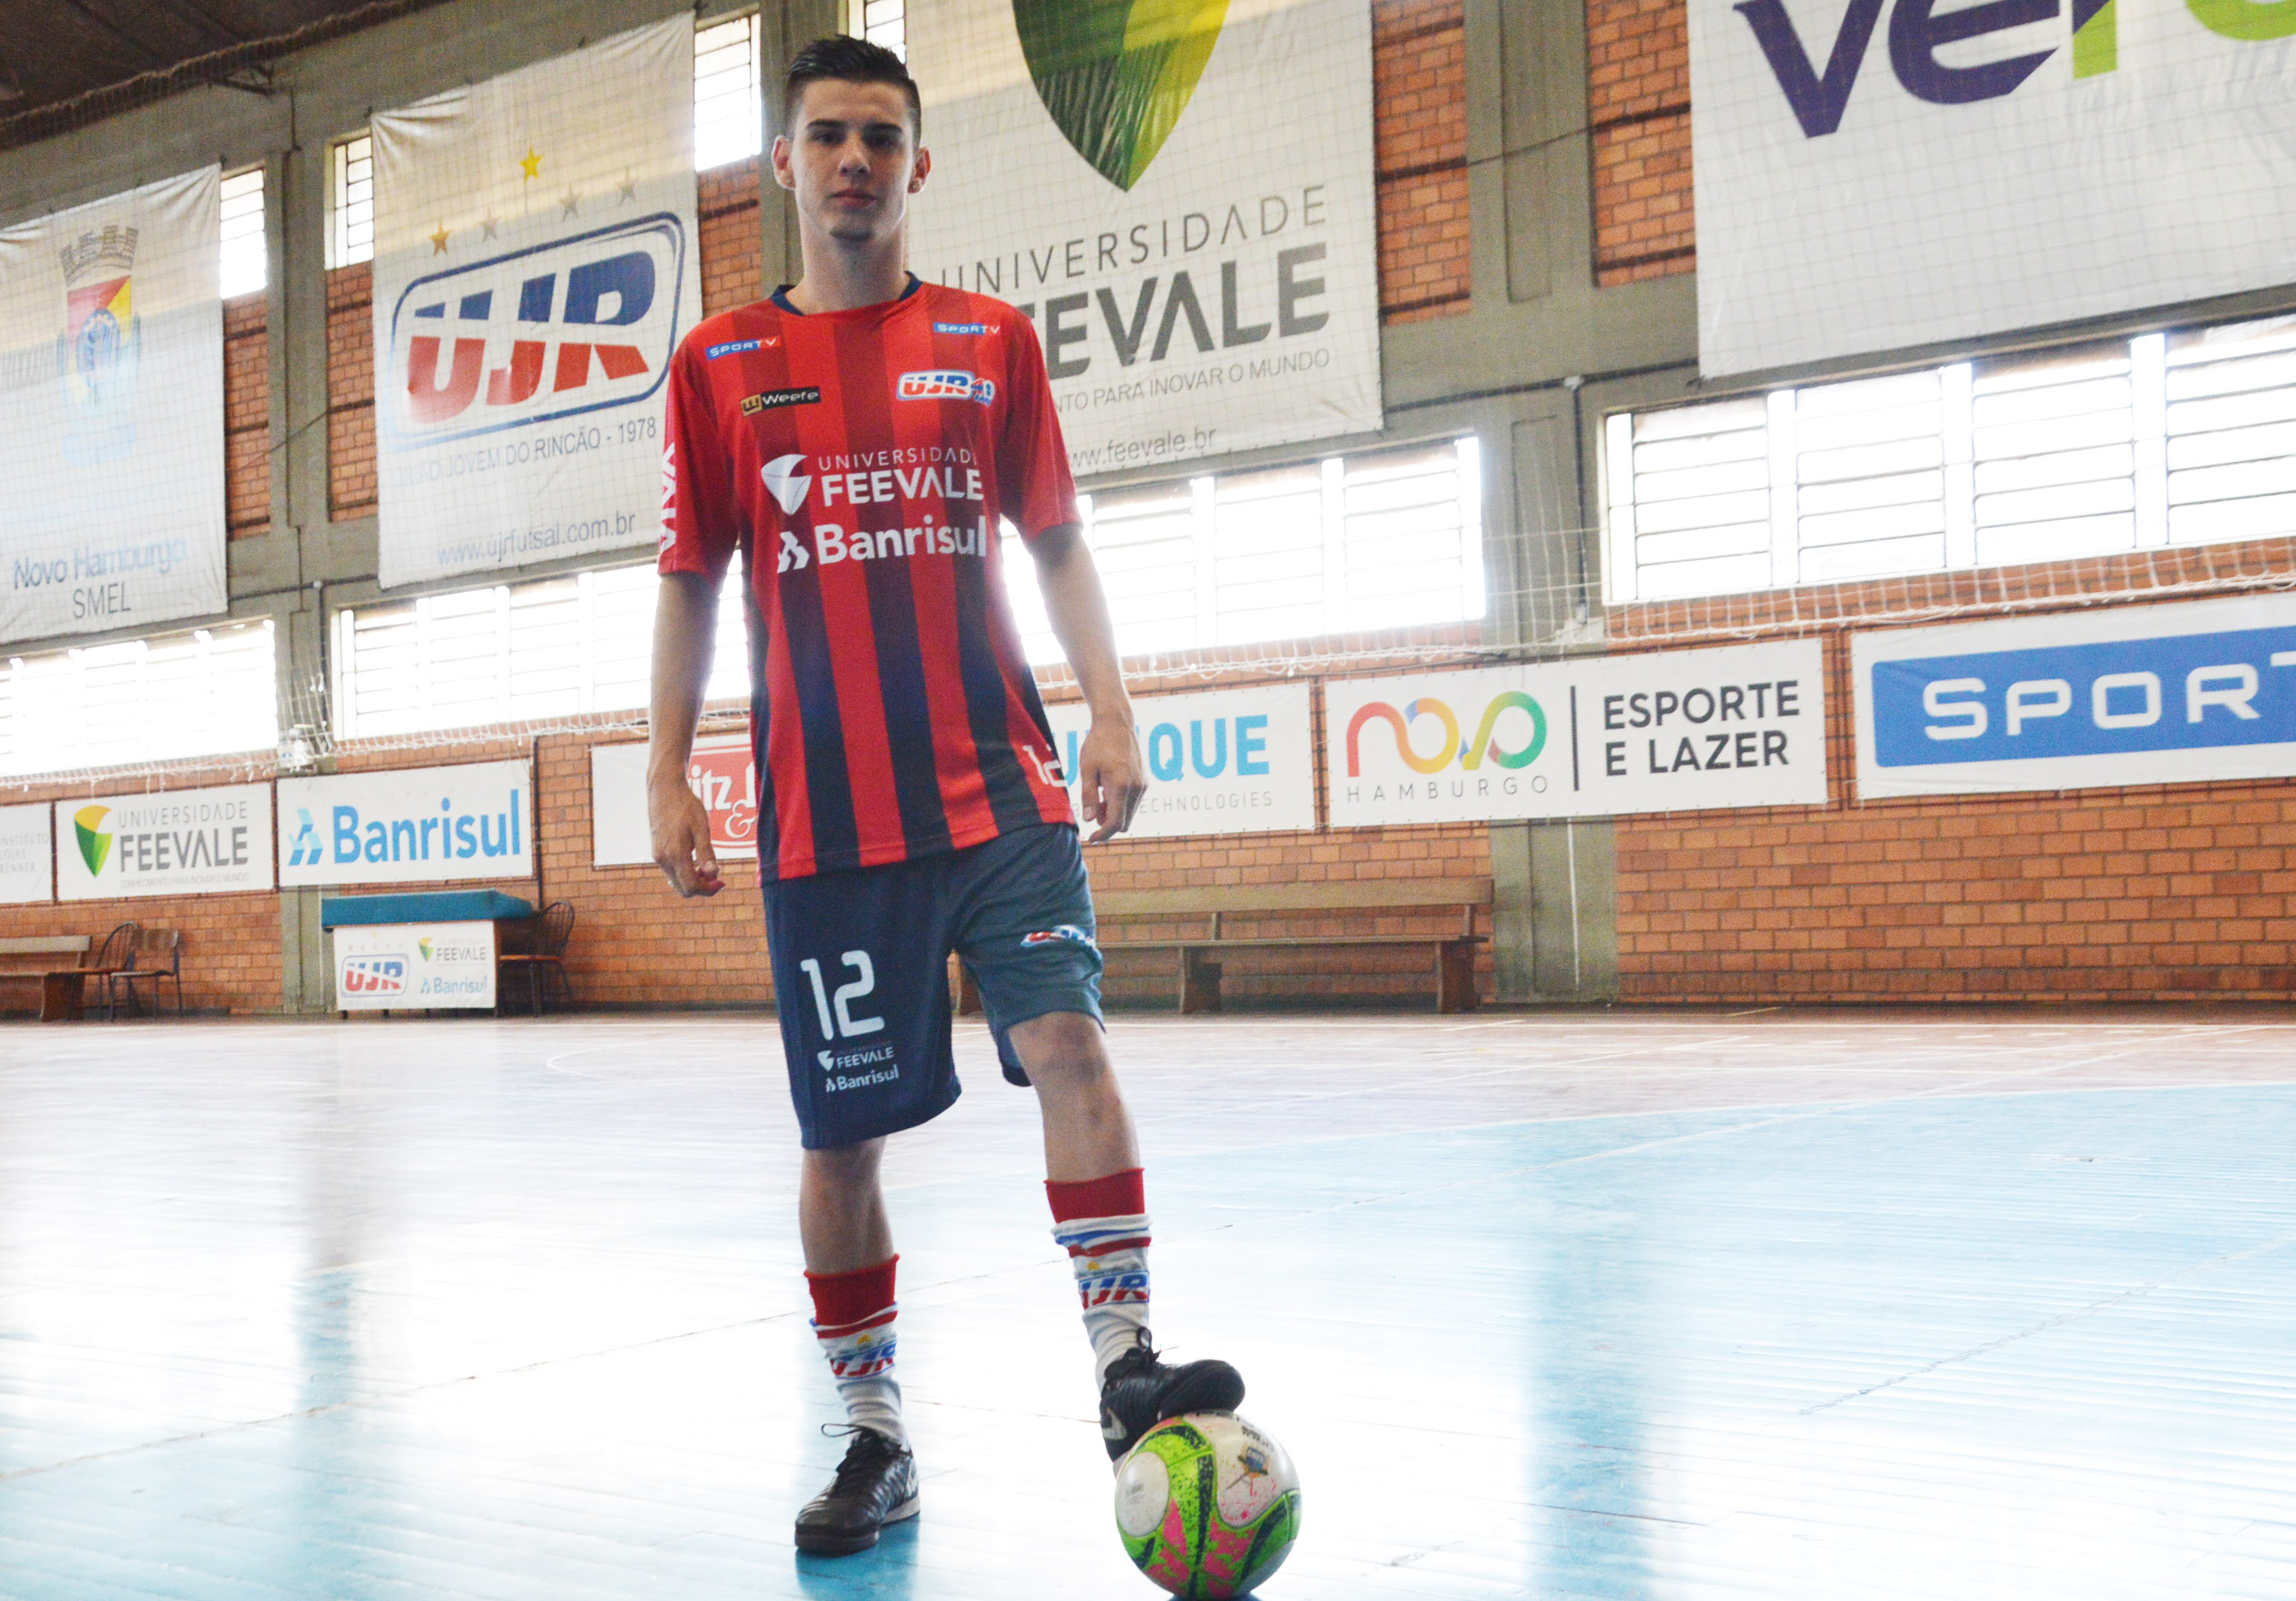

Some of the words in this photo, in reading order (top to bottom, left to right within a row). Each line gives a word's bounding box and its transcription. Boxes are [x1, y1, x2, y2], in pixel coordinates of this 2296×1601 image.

[1732, 0, 2296, 138] ver
[1017, 241, 1329, 380] EVALE
[407, 250, 655, 423] UJR
[903, 374, 968, 395] UJR
[1094, 384, 1144, 406] PARA
[1150, 367, 1223, 396] INOVAR
[1229, 364, 1244, 382] O
[1249, 348, 1330, 379] MUNDO
[506, 441, 530, 466] DO
[534, 427, 600, 460] RINCÃO
[618, 416, 656, 444] 1978
[821, 466, 984, 507] FEEVALE
[436, 511, 636, 565] www.ujrfutsal.com.br
[814, 514, 987, 565] Banrisul
[13, 558, 68, 590] Novo
[73, 538, 187, 575] Hamburgo
[72, 581, 131, 618] SMEL
[1604, 680, 1800, 730] ESPORTE
[1923, 651, 2296, 740] SPOR
[1606, 741, 1626, 777] E
[1649, 730, 1789, 774] LAZER
[1140, 791, 1273, 814] ECHNOLOGIES
[1347, 775, 1548, 802] HAMBURGO
[118, 801, 247, 829] UNIVERSIDADE
[333, 788, 520, 864] Banrisul
[119, 826, 249, 872] FEEVALE
[345, 961, 404, 992] UJR
[436, 947, 487, 961] FEEVALE
[433, 975, 488, 993] Banrisul
[800, 950, 885, 1041] 12
[836, 1046, 895, 1069] FEEVALE
[836, 1064, 899, 1090] Banrisul
